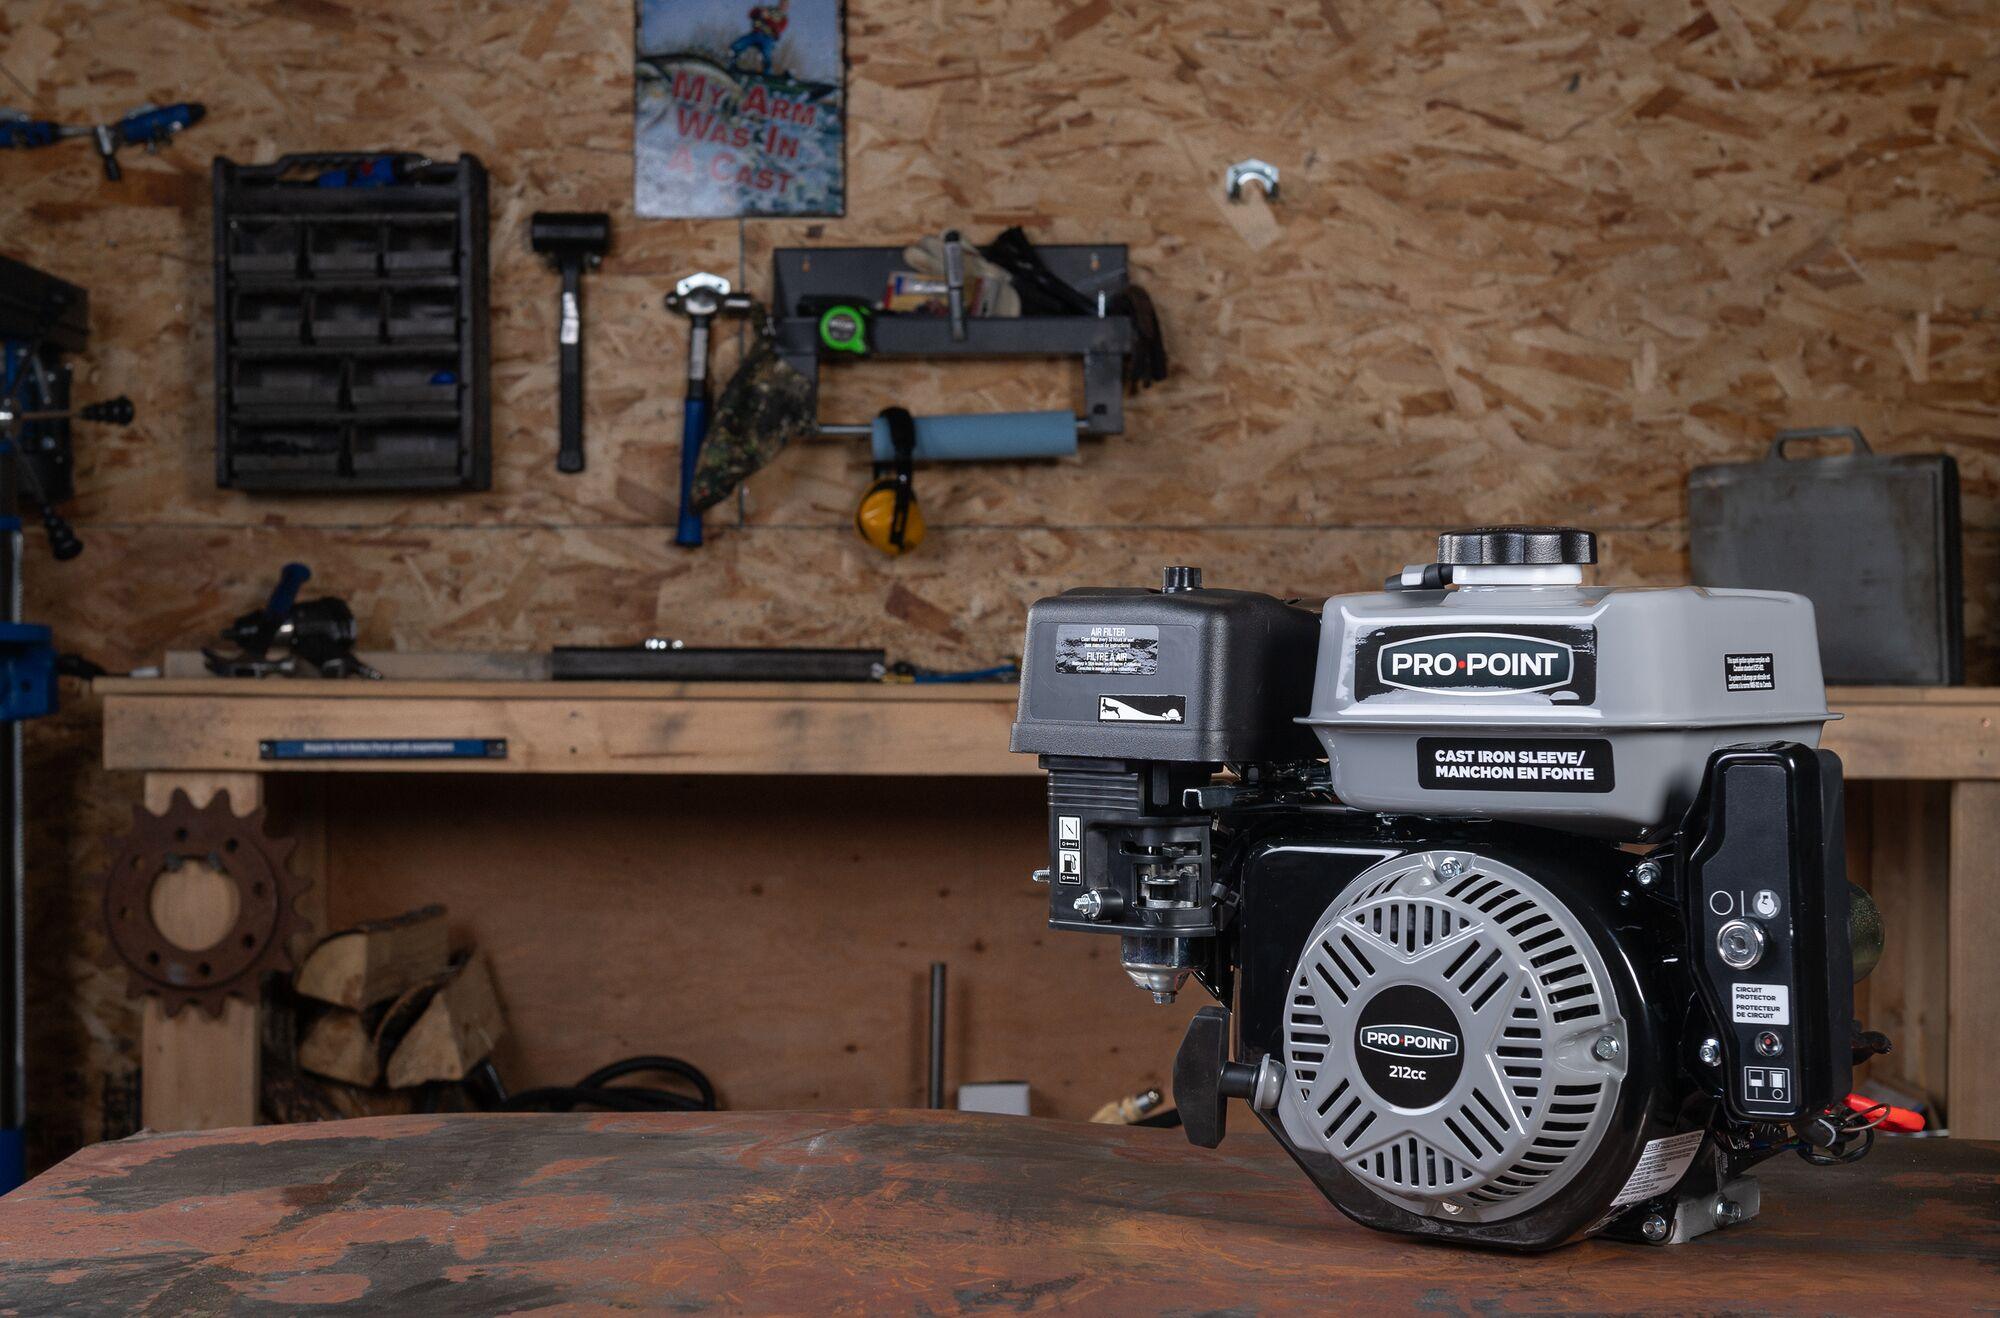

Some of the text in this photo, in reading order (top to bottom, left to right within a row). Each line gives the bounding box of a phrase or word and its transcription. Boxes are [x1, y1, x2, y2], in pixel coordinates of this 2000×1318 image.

[667, 144, 694, 174] A
[1090, 627, 1126, 637] AIR FILTER
[1116, 652, 1128, 661] AIR
[1435, 749, 1586, 767] CAST IRON SLEEVE/
[1435, 765, 1595, 781] MANCHON EN FONTE
[1735, 993, 1777, 1002] PROTECTOR
[1736, 1004, 1781, 1012] PROTECTEUR
[1388, 1065, 1427, 1081] 212cc
